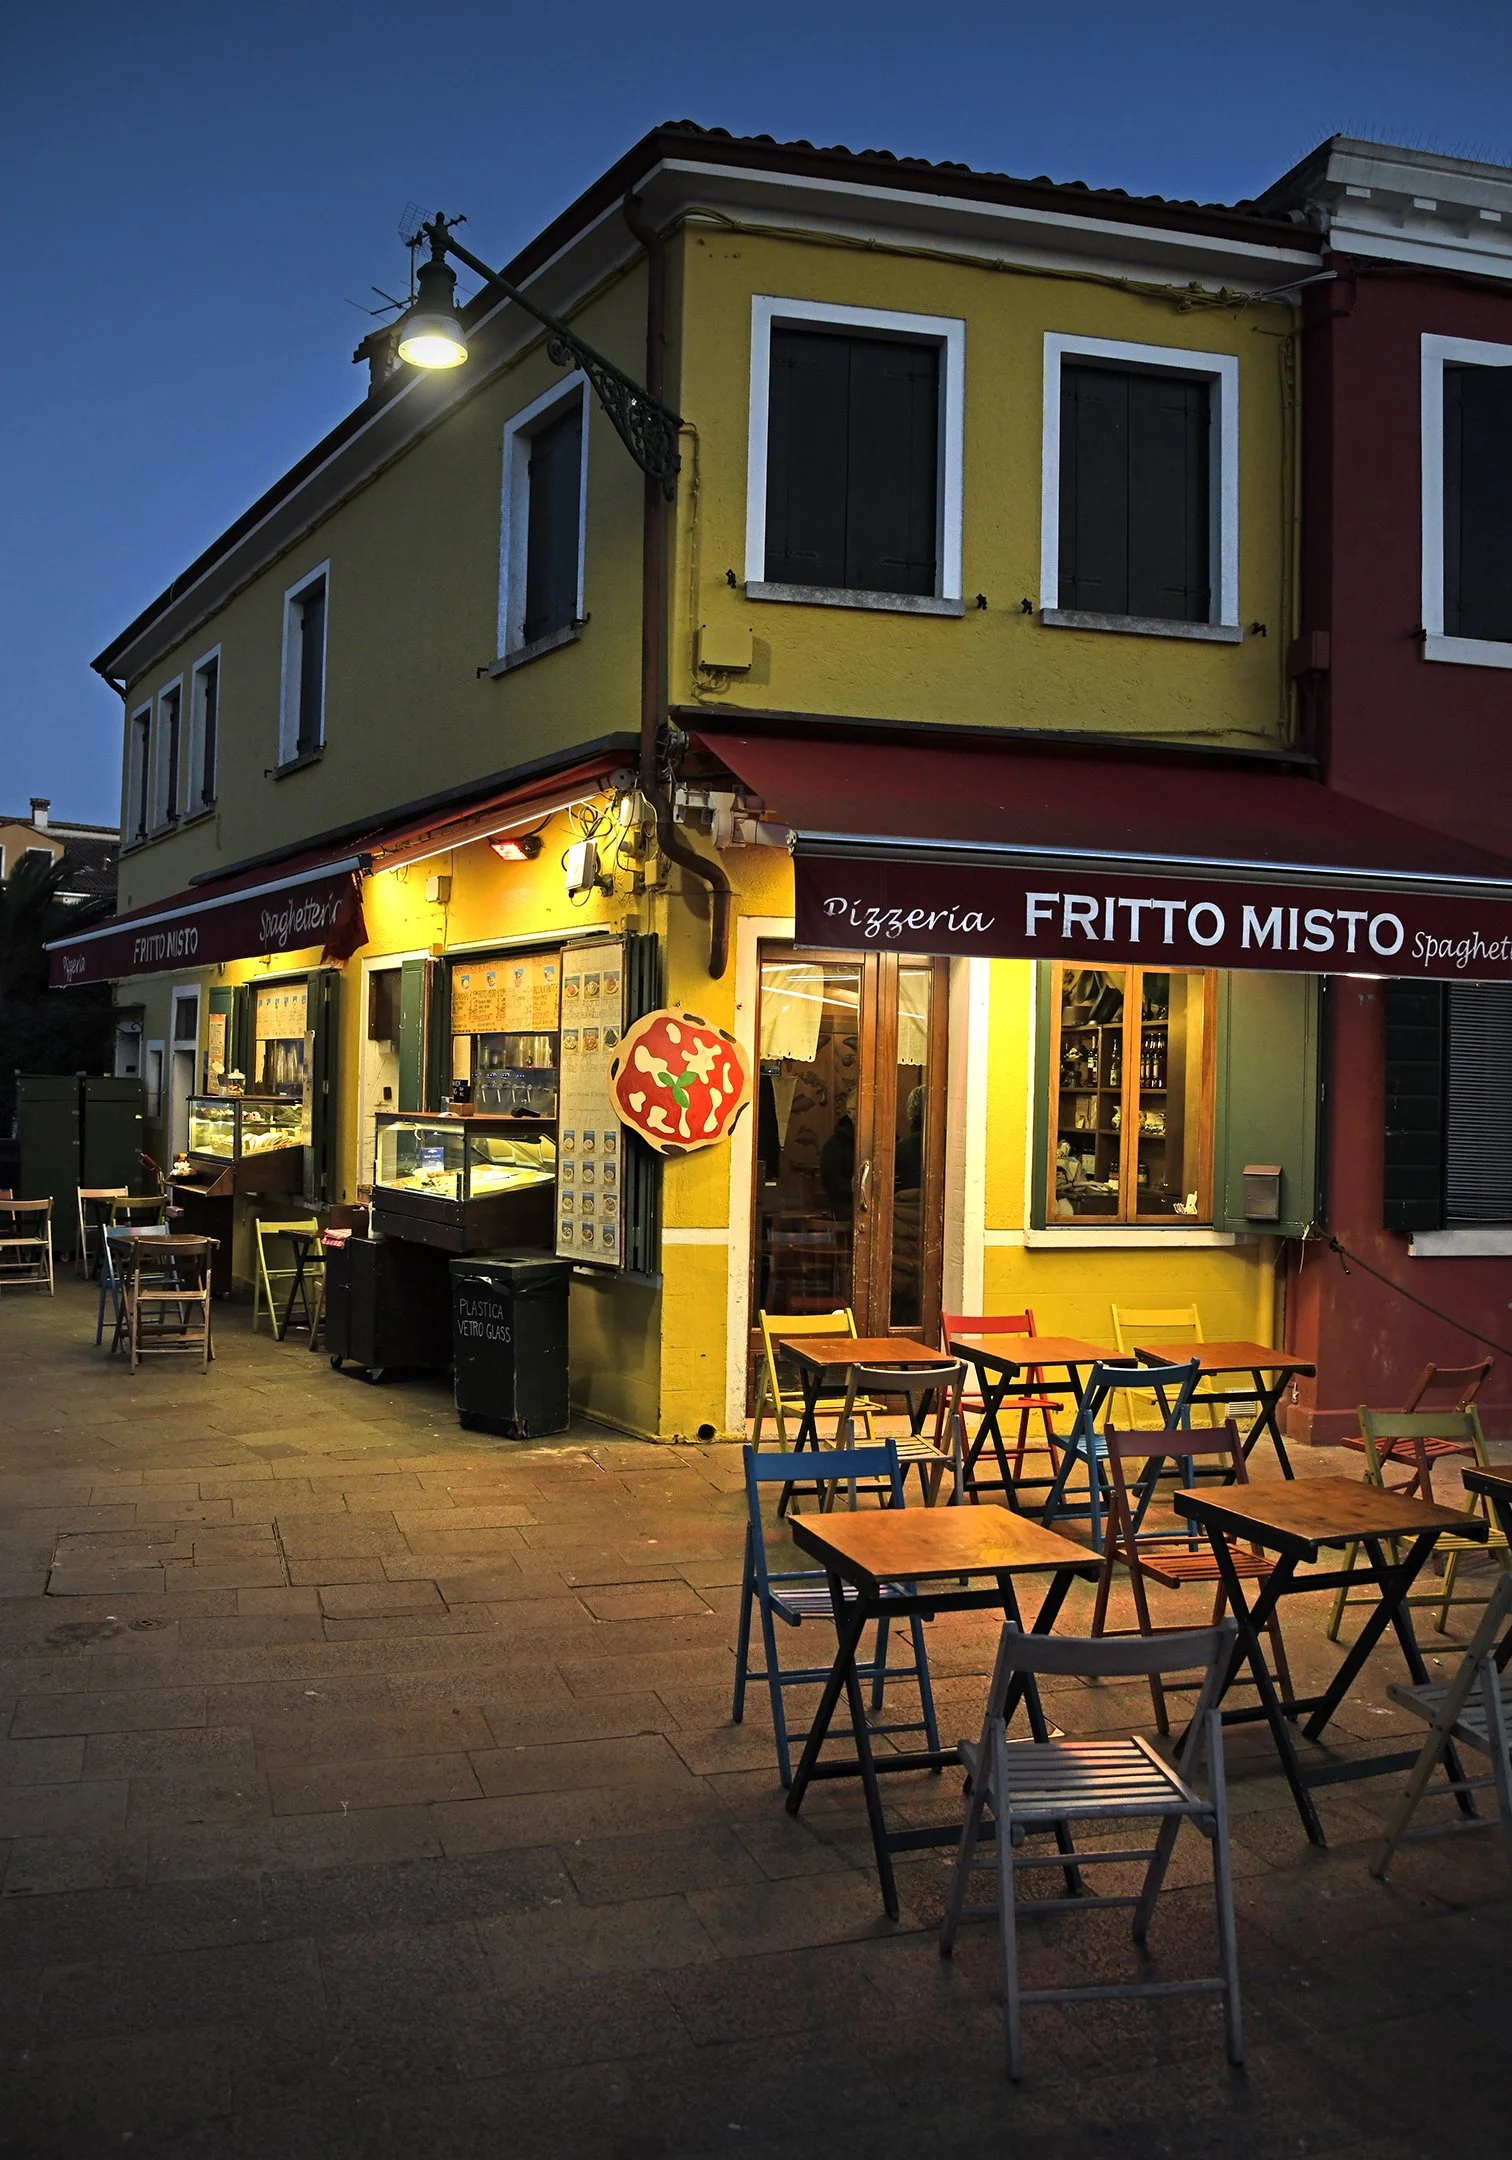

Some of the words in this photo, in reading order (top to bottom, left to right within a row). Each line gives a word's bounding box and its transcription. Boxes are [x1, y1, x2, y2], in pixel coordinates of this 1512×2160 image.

[133, 933, 165, 964] FRITTO
[166, 927, 198, 959] MISTO
[823, 896, 995, 939] Pizzeria
[1025, 892, 1225, 947] FRITTO
[1240, 905, 1405, 956] MISTO
[1411, 931, 1512, 969] Spaghet
[459, 1298, 504, 1320] PLASTICA
[457, 1320, 484, 1337] VETRO
[486, 1323, 512, 1343] GLASS
